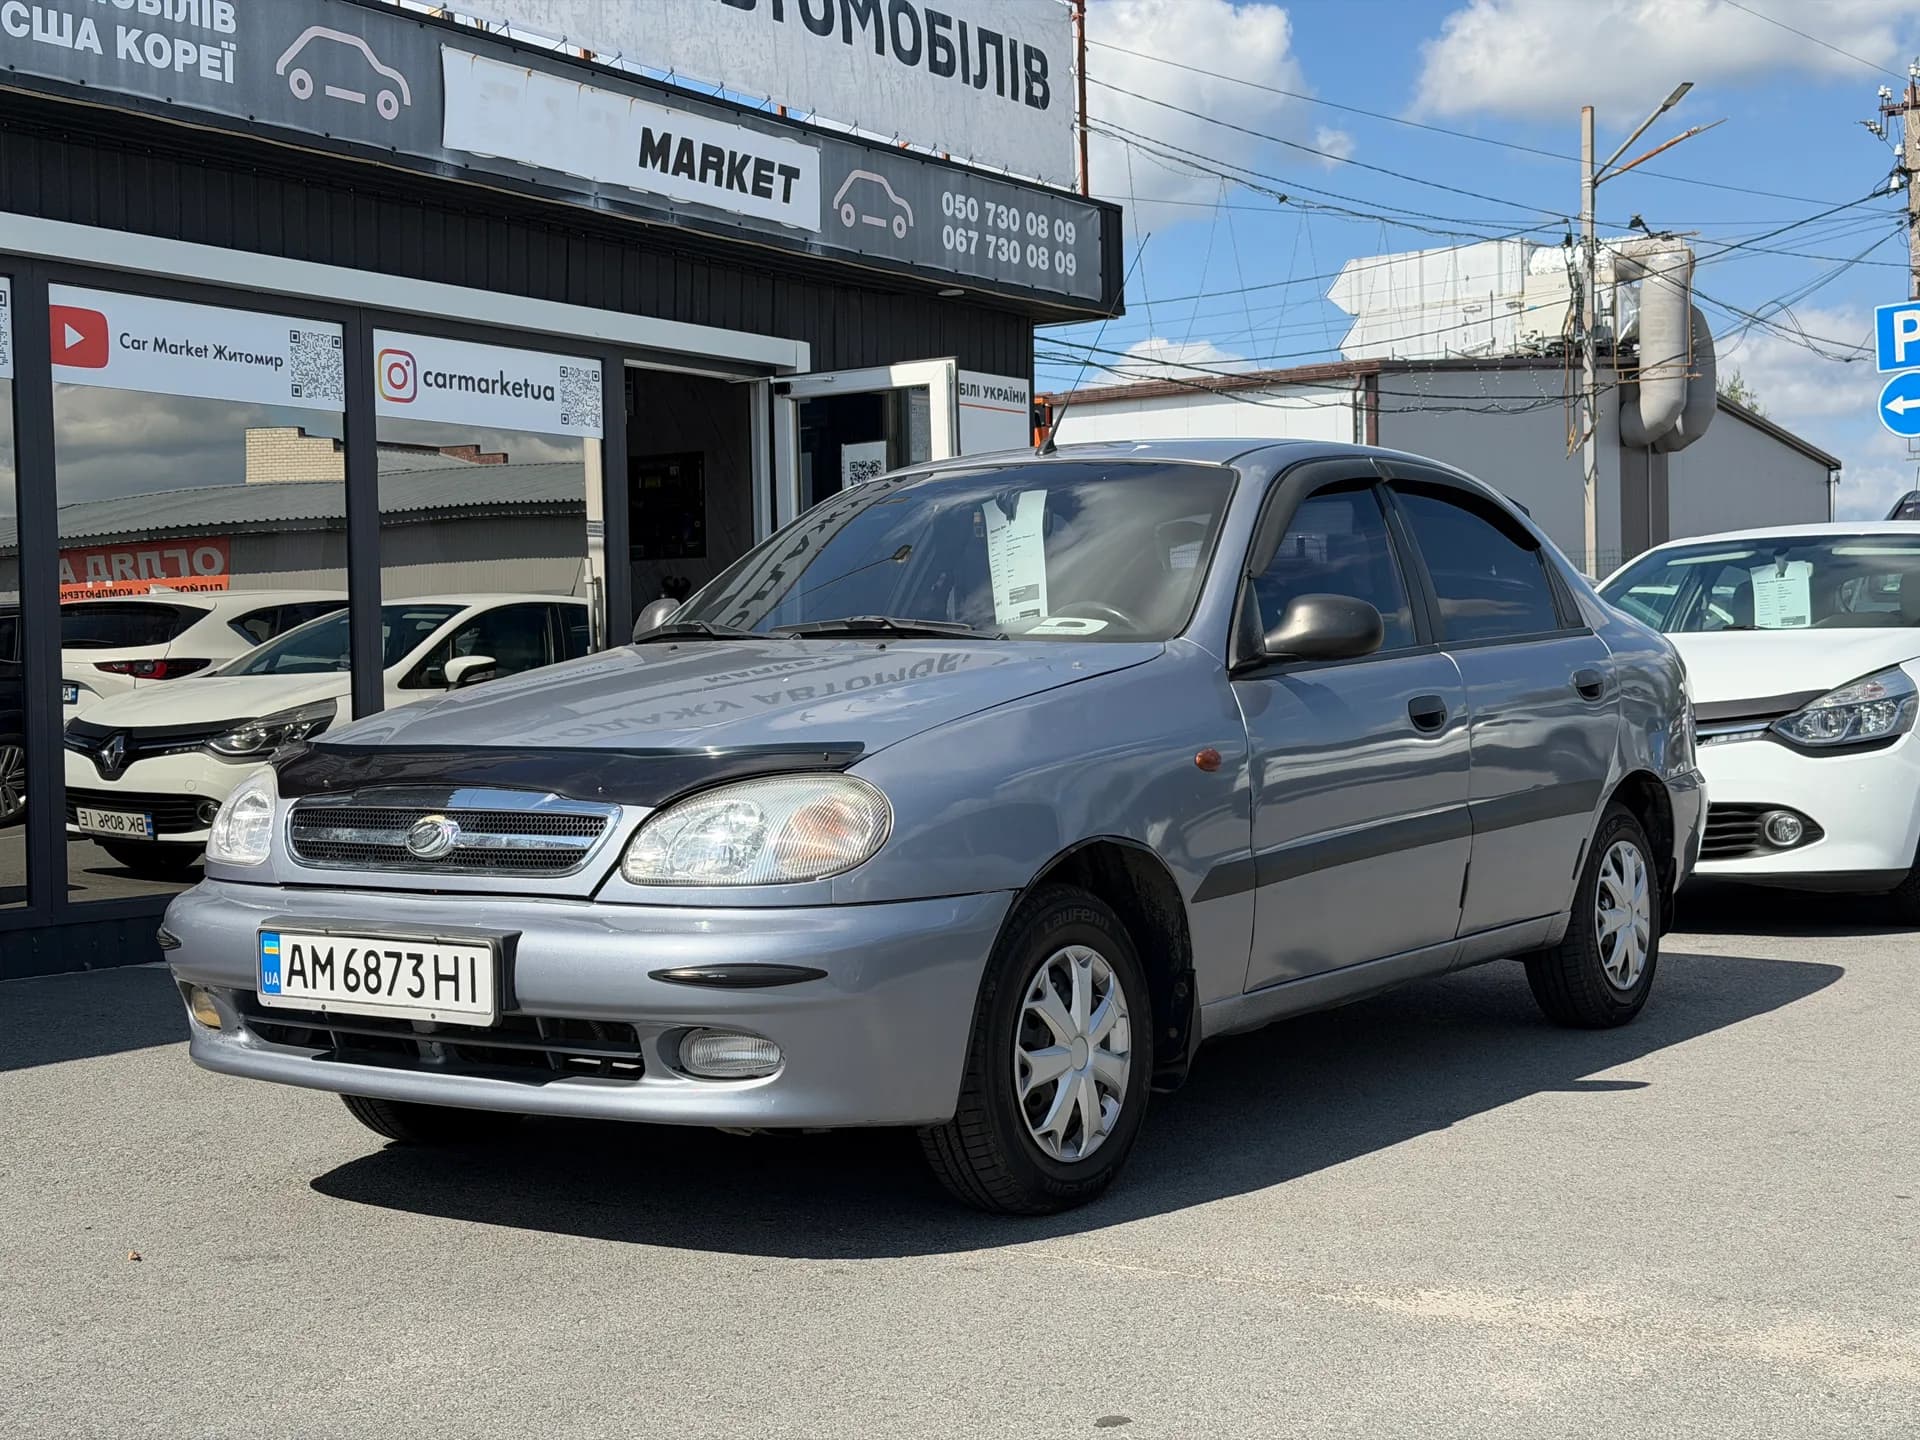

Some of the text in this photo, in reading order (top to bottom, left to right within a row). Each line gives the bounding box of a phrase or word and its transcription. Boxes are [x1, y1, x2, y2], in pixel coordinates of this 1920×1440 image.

[1, 1, 237, 84] США КОРЕЇ
[719, 0, 1051, 110] ОМОБІЛІВ
[638, 126, 801, 204] MARKET
[941, 191, 1076, 245] 050 730 08 09
[942, 224, 1077, 277] 067 730 08 09
[119, 332, 284, 371] Car Market Житомир
[1893, 309, 1920, 363] P
[423, 369, 555, 401] carmarketua
[983, 385, 1026, 404] УКРАЇНИ
[264, 971, 280, 986] UA
